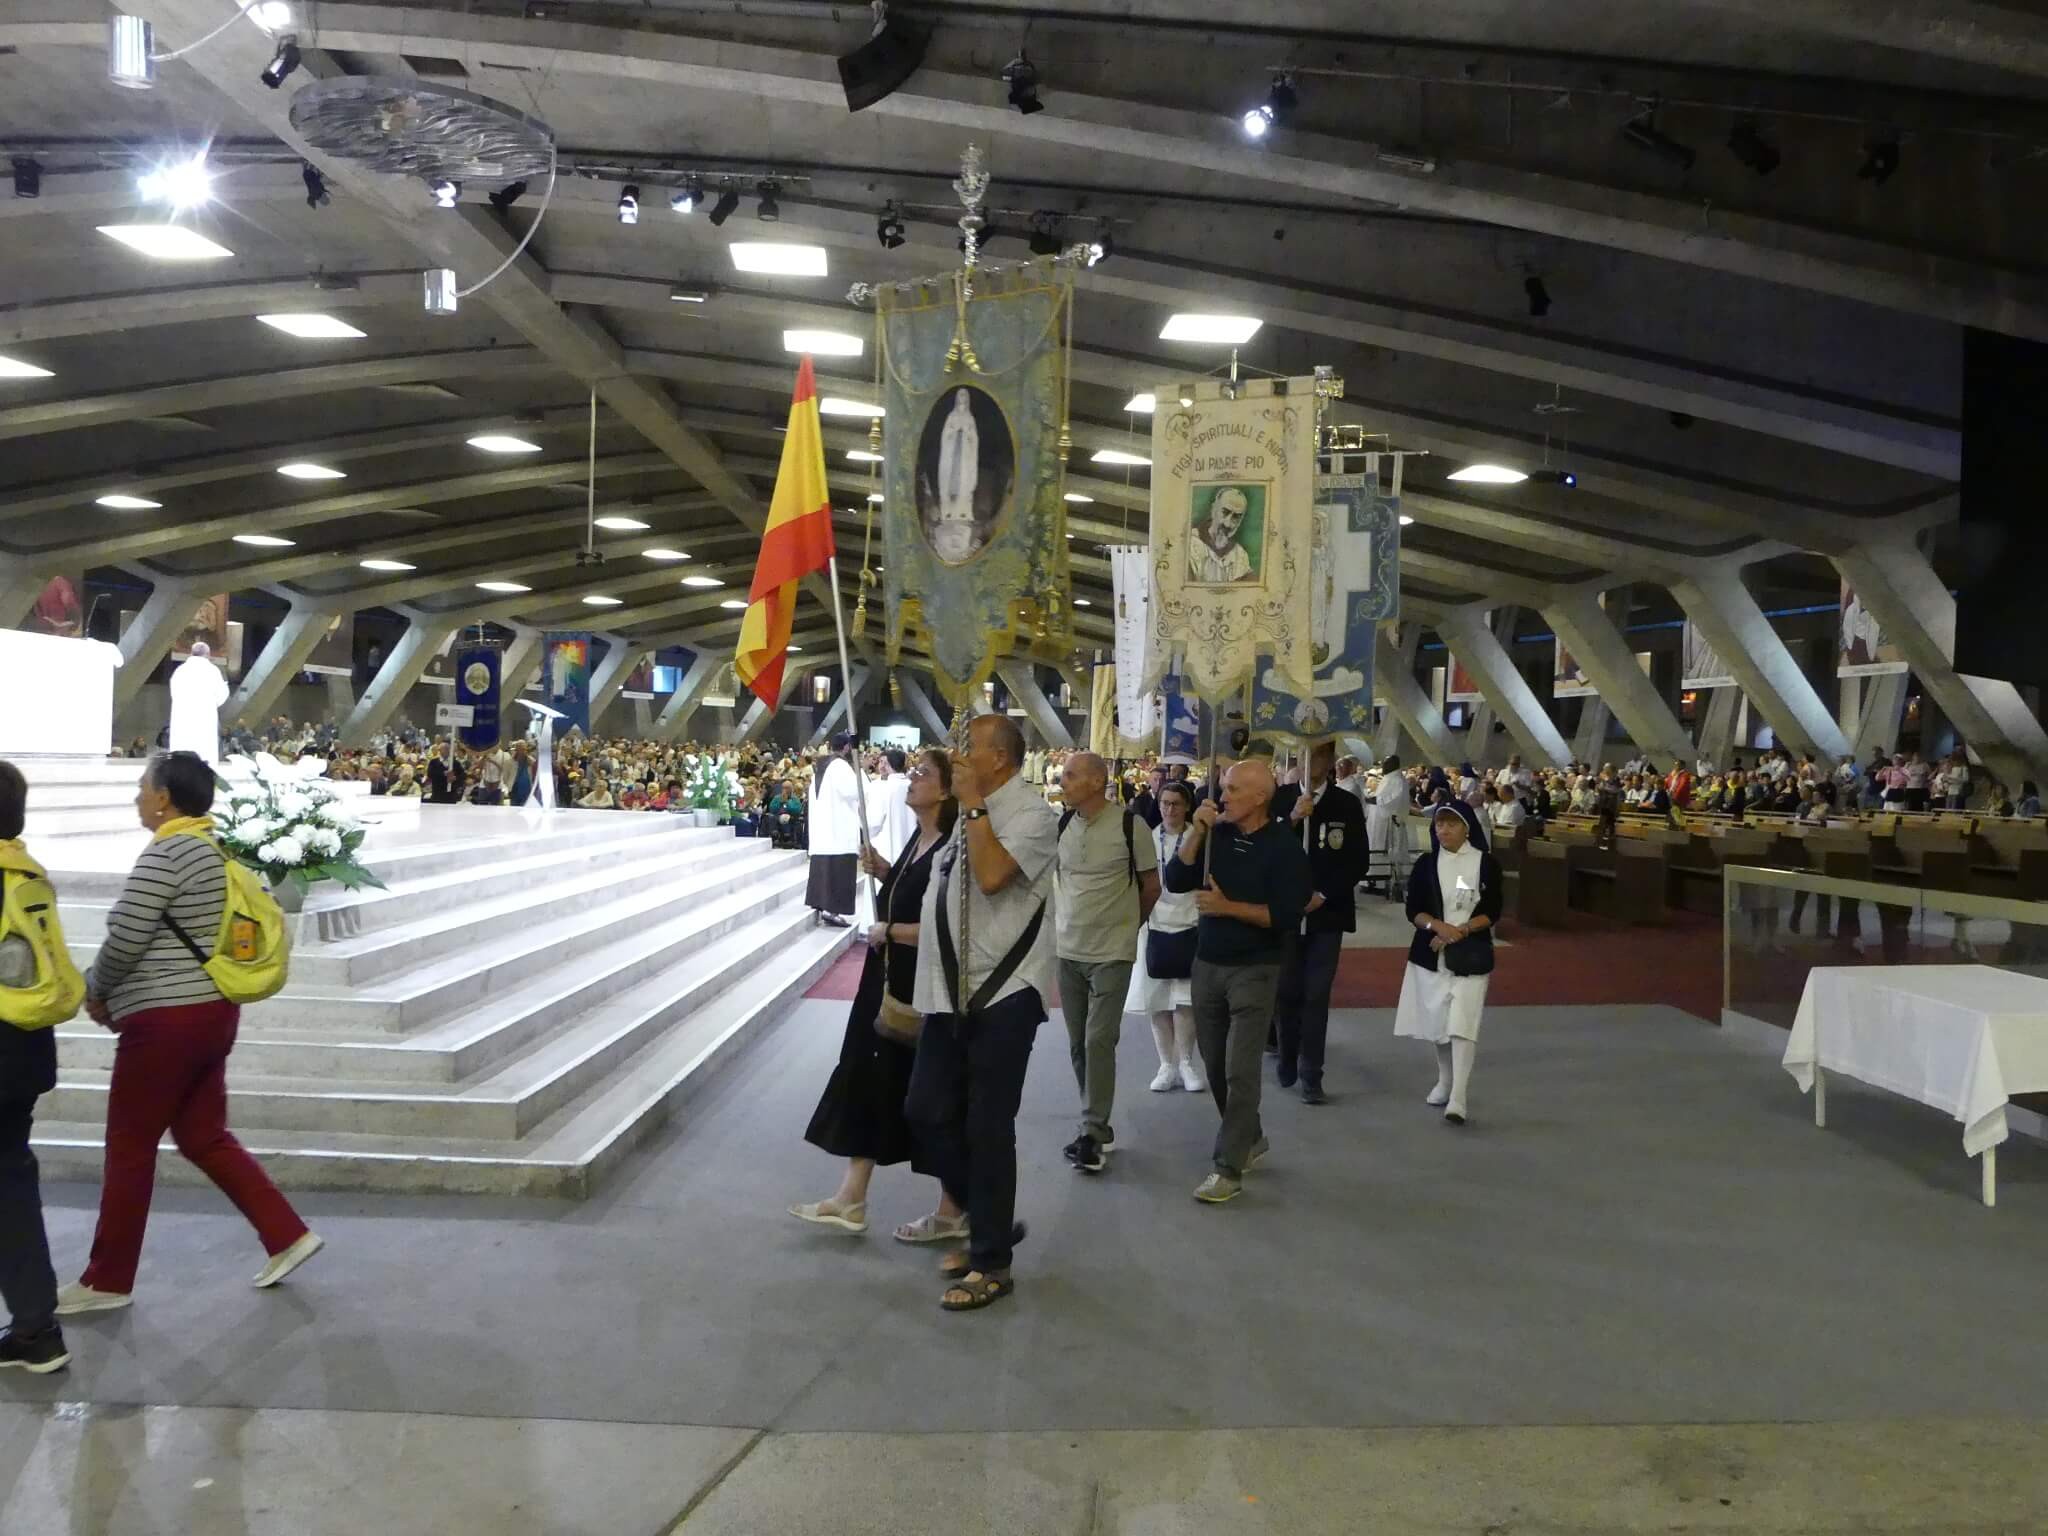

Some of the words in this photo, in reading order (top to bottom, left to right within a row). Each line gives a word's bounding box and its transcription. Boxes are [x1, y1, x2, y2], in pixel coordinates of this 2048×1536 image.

[1192, 423, 1254, 449] SPIRITUALI
[1255, 430, 1267, 444] E
[1195, 457, 1205, 473] DI
[1244, 455, 1265, 470] PIO
